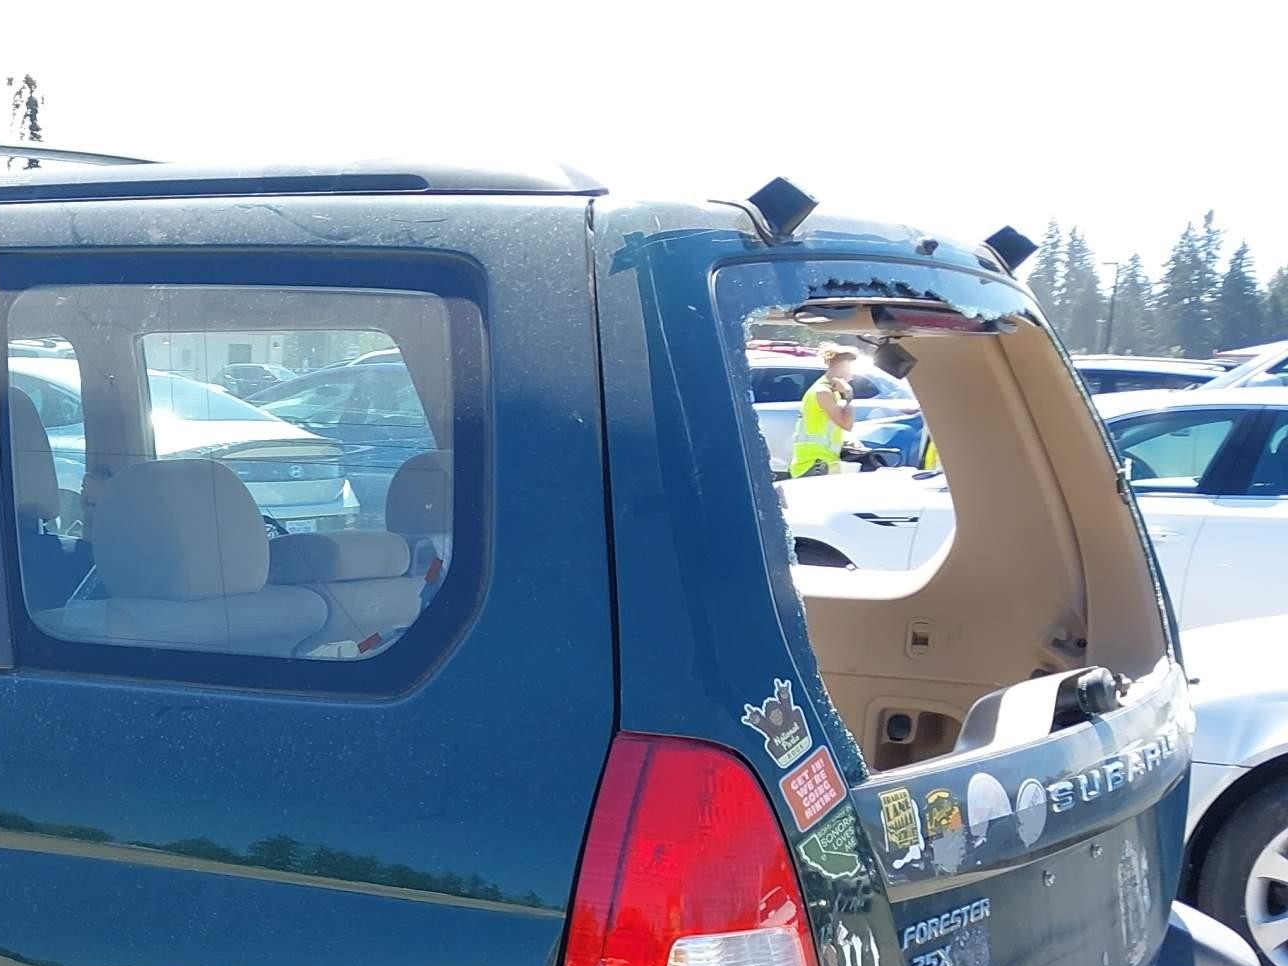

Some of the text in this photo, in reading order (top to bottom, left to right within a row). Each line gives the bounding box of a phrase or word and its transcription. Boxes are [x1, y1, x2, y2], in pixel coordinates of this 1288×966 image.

[790, 769, 810, 790] GET
[803, 780, 831, 807] GOING
[804, 788, 837, 819] HIKING
[821, 815, 855, 847] SONORA
[832, 826, 855, 850] LOVES
[845, 837, 858, 851] ME
[903, 898, 990, 951] FORESTER
